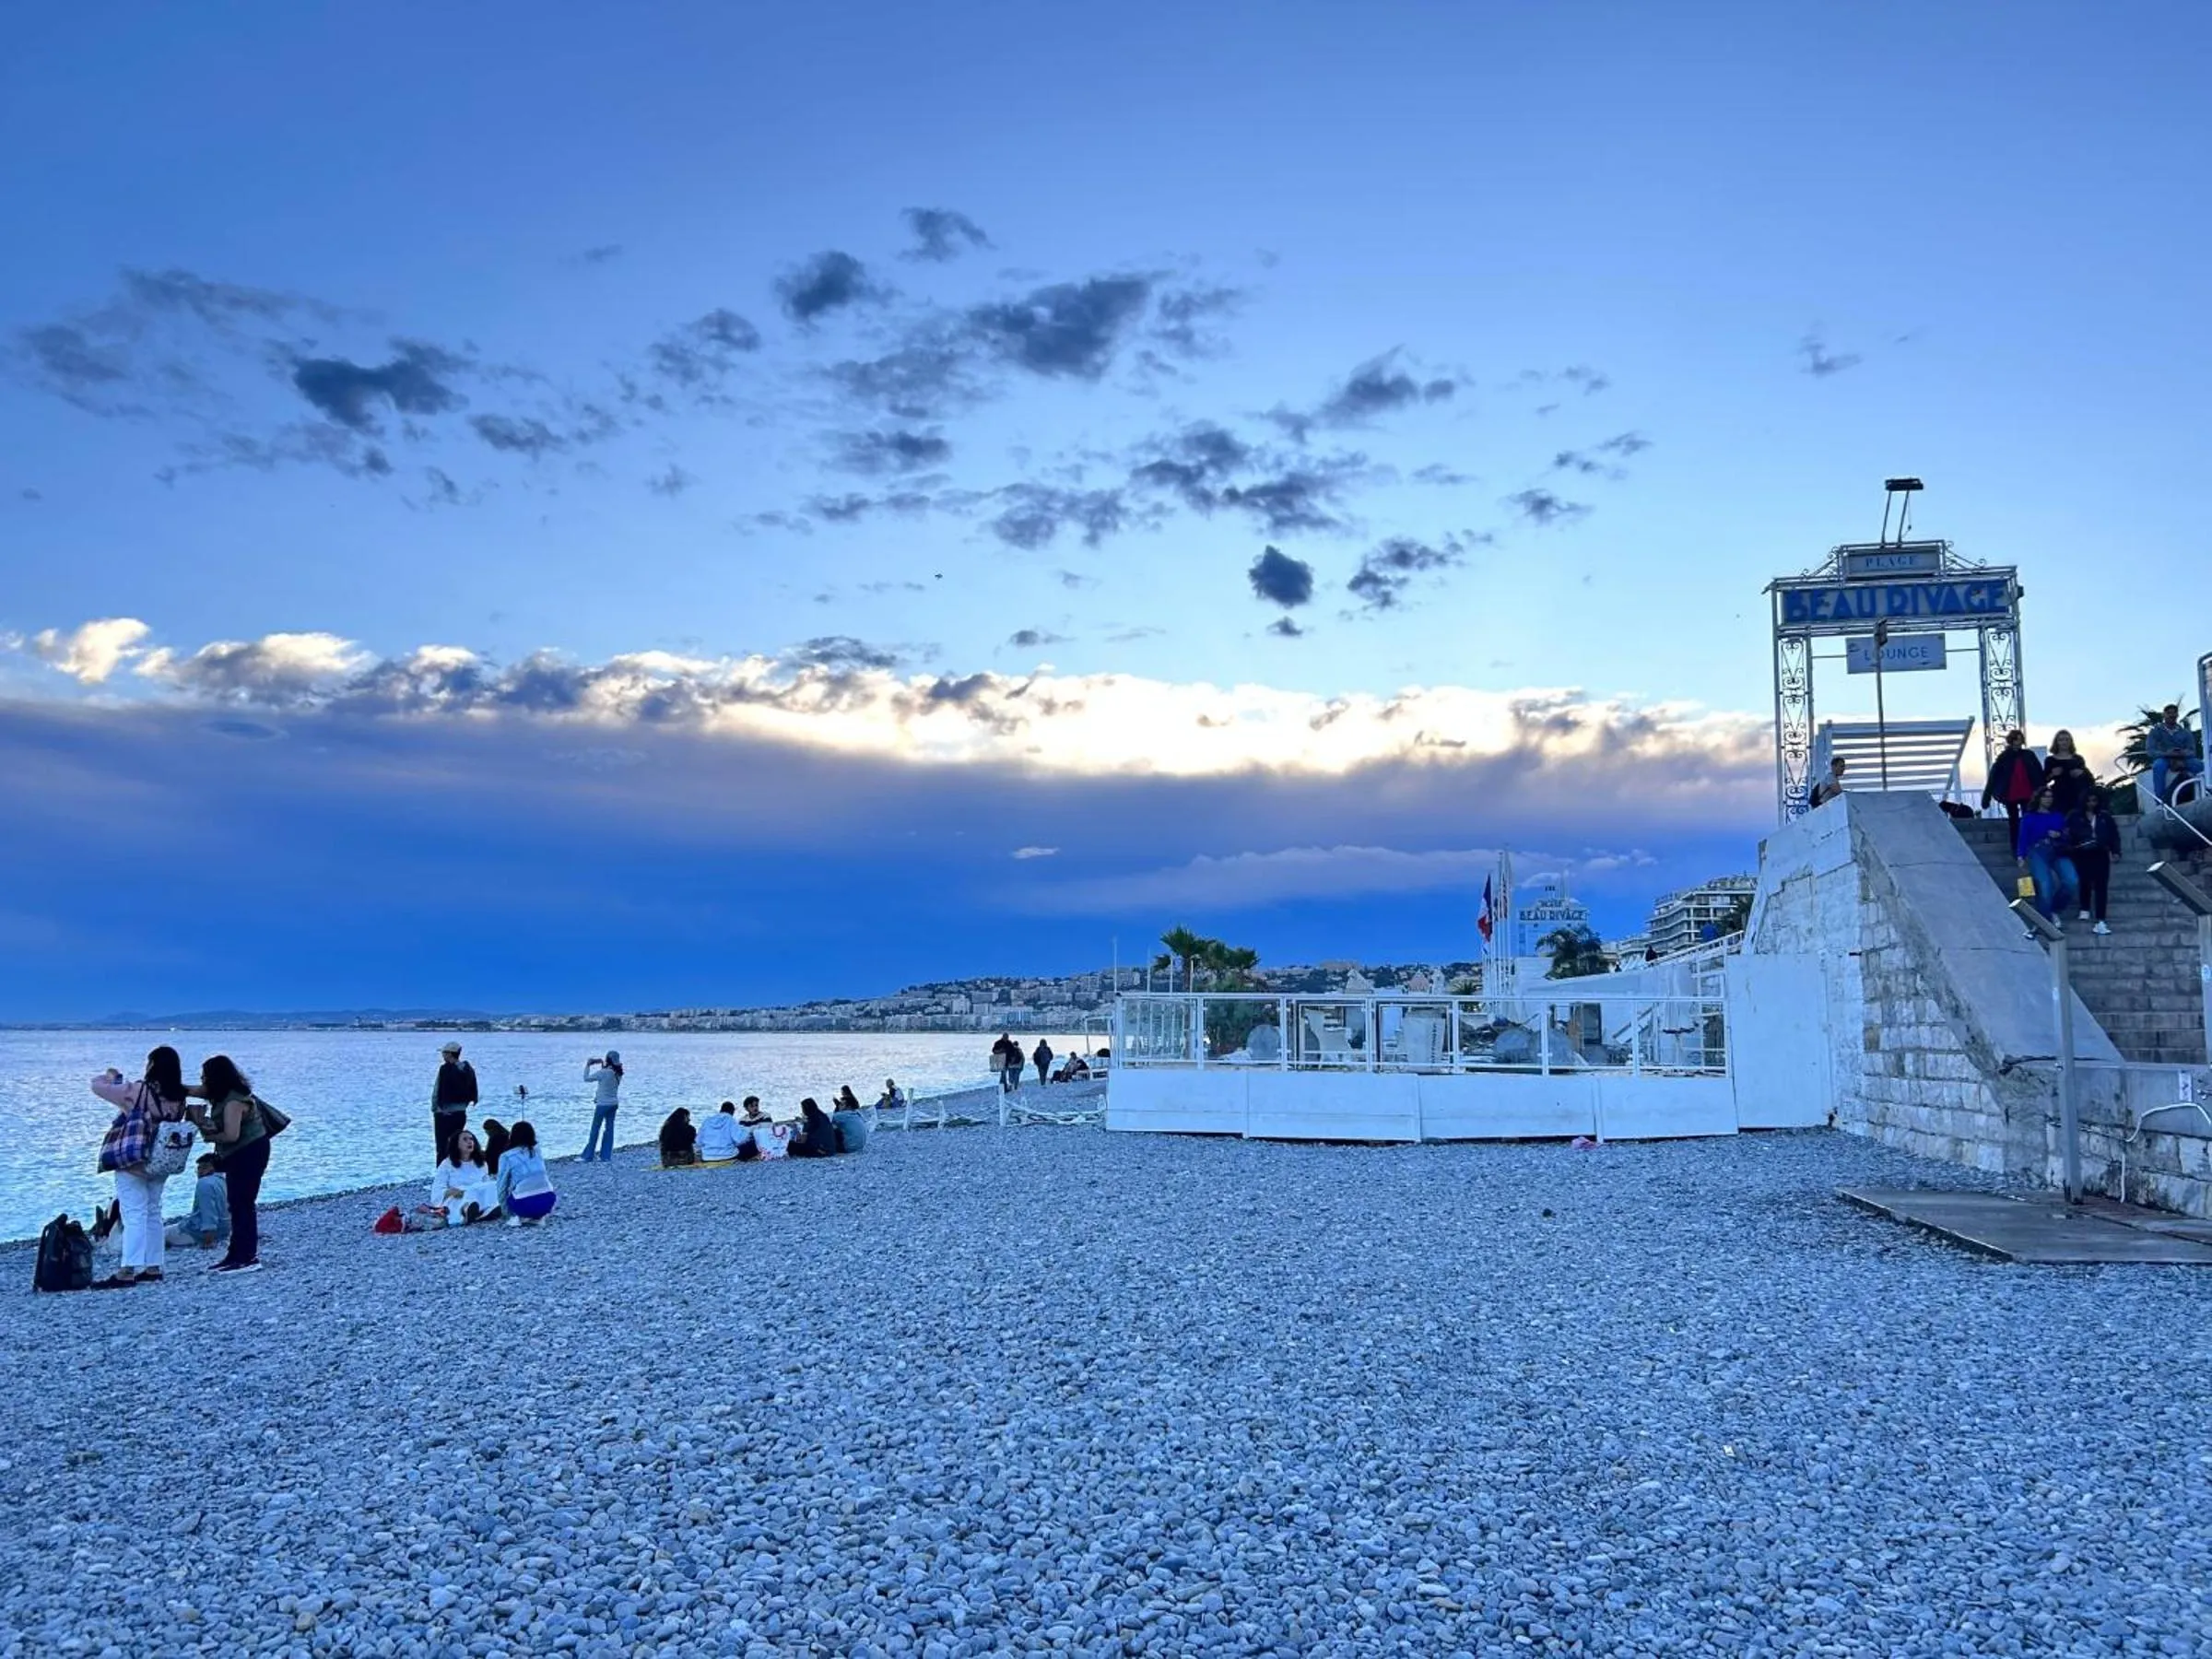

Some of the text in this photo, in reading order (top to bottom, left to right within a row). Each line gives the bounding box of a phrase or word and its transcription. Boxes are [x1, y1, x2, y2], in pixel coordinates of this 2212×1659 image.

[1865, 556, 1917, 568] PLAGE
[1786, 581, 2009, 620] BEAU RIVAGE
[1520, 910, 1547, 921] BEAU
